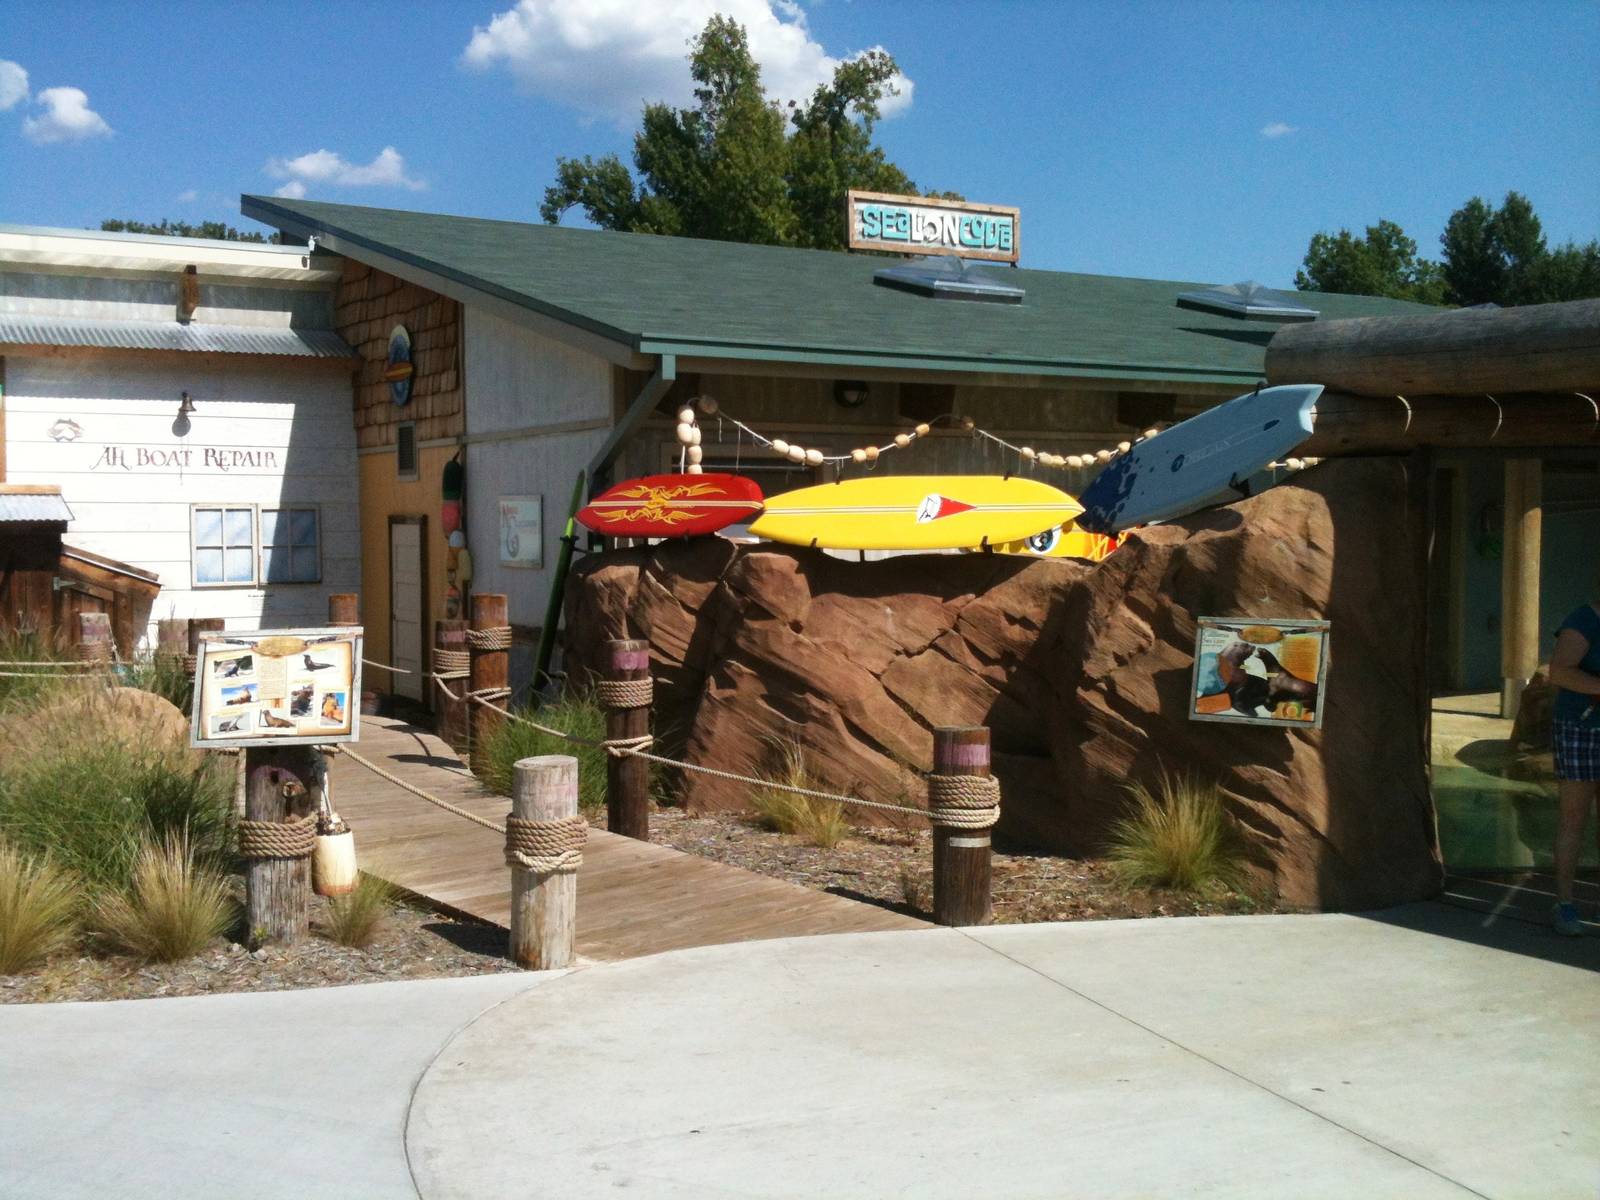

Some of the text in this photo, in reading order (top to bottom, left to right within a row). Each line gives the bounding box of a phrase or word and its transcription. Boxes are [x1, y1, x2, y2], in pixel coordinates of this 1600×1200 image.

[862, 205, 1013, 251] SEA LION COVE
[136, 447, 193, 468] BOAT
[204, 448, 278, 472] REPAIR
